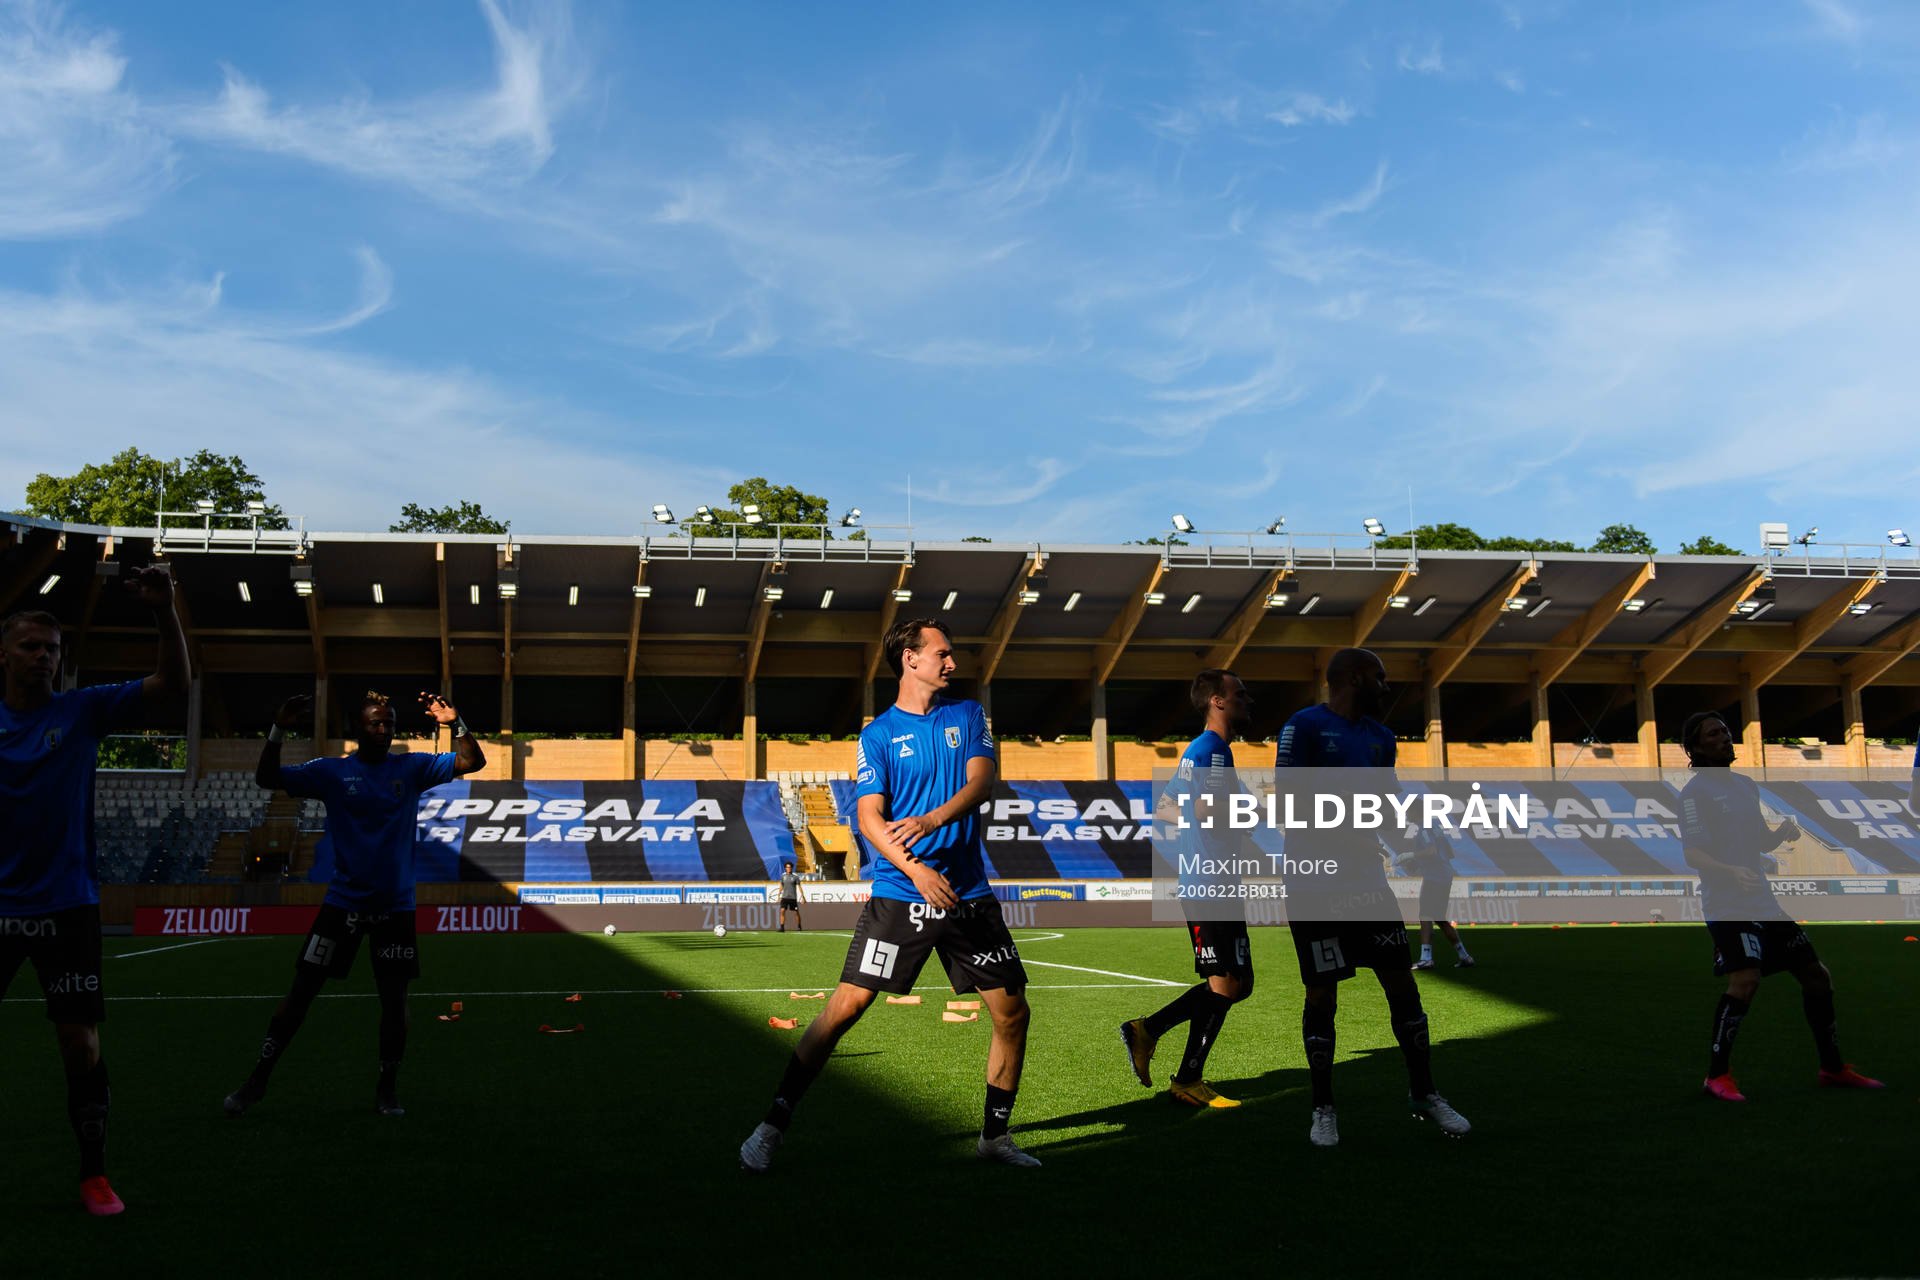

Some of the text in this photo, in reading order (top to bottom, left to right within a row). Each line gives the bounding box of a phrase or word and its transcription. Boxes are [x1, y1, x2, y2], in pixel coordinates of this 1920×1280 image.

[416, 823, 726, 842] R BLÅSVART
[1852, 821, 1915, 839] ÄR
[1022, 888, 1073, 899] Skuttunge
[1771, 881, 1817, 891] NORDIC
[162, 908, 251, 934] ZELLOUT
[436, 906, 522, 932] ZELLOUT
[702, 904, 781, 929] ZELLOUT
